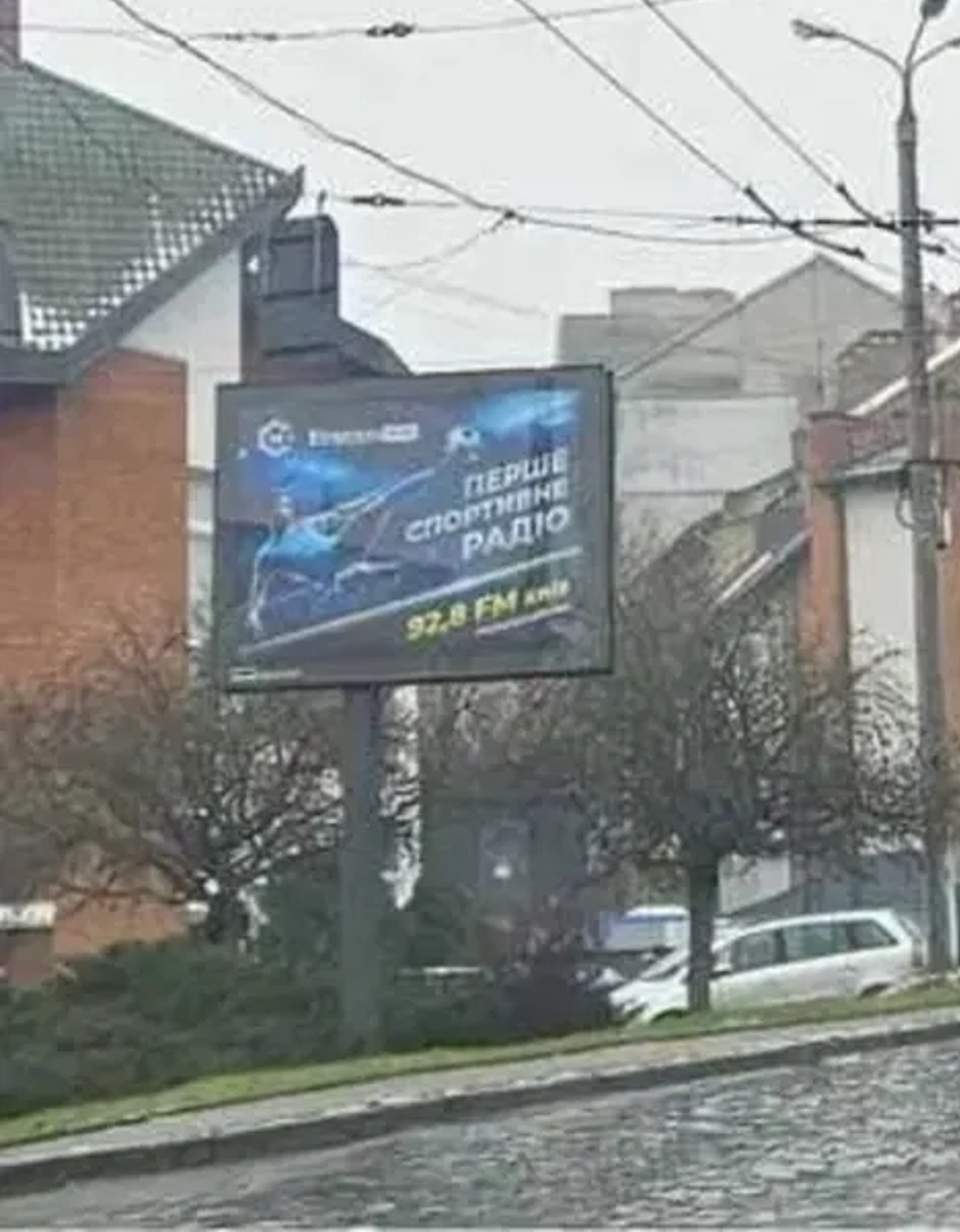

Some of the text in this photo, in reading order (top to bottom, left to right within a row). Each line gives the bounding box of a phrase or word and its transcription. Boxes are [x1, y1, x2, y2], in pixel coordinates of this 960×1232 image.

[463, 447, 568, 499] ПЕРШЕ
[404, 477, 568, 543] СПОРТИВНЕ
[461, 505, 570, 560] РАДІО
[475, 589, 519, 624] FM
